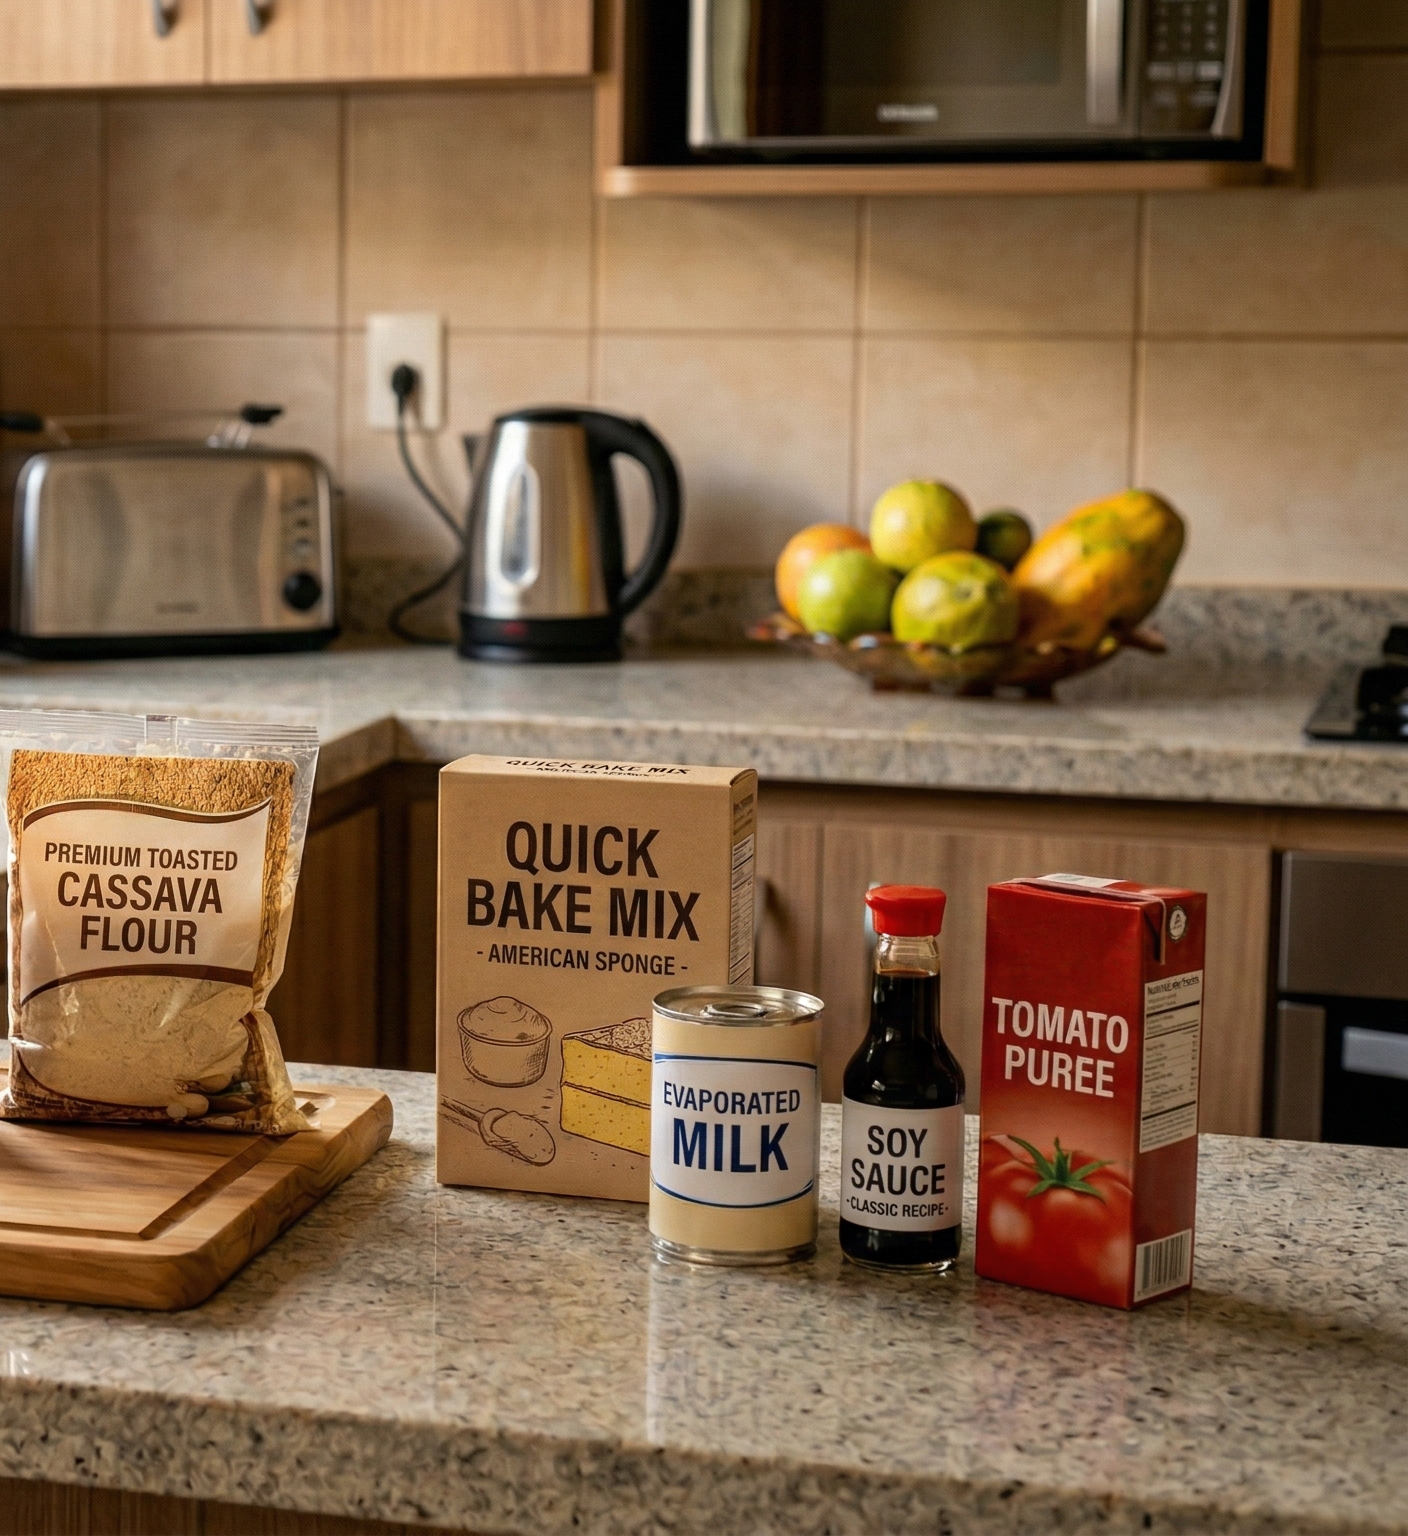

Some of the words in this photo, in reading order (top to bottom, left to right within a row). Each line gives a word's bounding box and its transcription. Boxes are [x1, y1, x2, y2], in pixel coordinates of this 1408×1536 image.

[506, 760, 577, 768] QUICK
[648, 767, 691, 775] MIX
[44, 841, 141, 868] PREMIUM
[147, 847, 238, 872] TOASTED
[505, 820, 661, 879] QUICK
[57, 871, 223, 914] CASSAVA
[467, 878, 592, 935] BAKE
[609, 887, 701, 942] MIX
[80, 915, 198, 955] FLOUR
[488, 943, 590, 970] AMERICAN
[595, 951, 676, 976] SPONGE
[991, 996, 1129, 1054] TOMATO
[1004, 1043, 1115, 1098] PUREE
[663, 1080, 801, 1115] EVAPORATED
[673, 1117, 790, 1173] MILK
[867, 1124, 928, 1158] SOY
[851, 1158, 946, 1196] SAUCE
